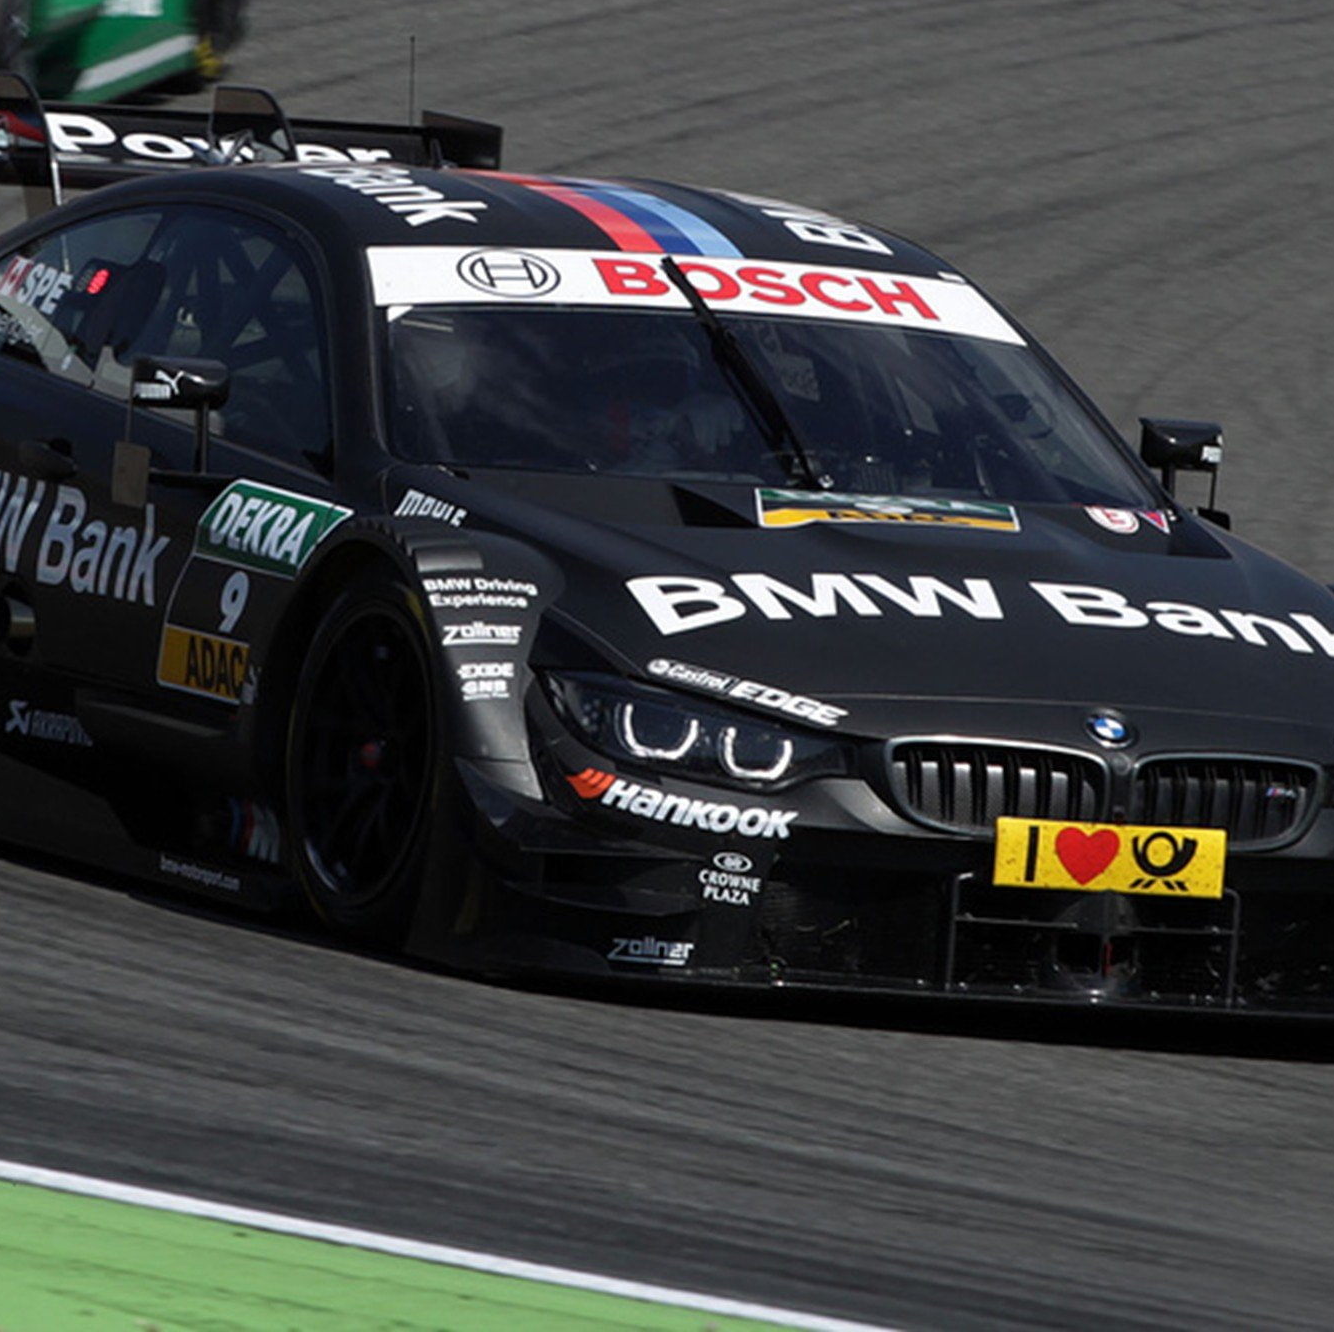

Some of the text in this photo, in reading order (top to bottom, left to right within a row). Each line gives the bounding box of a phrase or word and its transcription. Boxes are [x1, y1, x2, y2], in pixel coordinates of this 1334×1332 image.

[589, 256, 941, 322] BOSCH
[36, 483, 170, 606] Bank
[209, 491, 317, 566] DEKRA
[219, 570, 251, 633] 9
[422, 577, 539, 596] BMW Driving
[428, 592, 529, 609] Experience
[624, 570, 1005, 638] BMW
[184, 634, 246, 701] ADAC
[668, 663, 849, 727] Castrol EDGE
[698, 868, 762, 893] CROWNE
[1023, 825, 1040, 884] I
[703, 883, 750, 906] PLAZA
